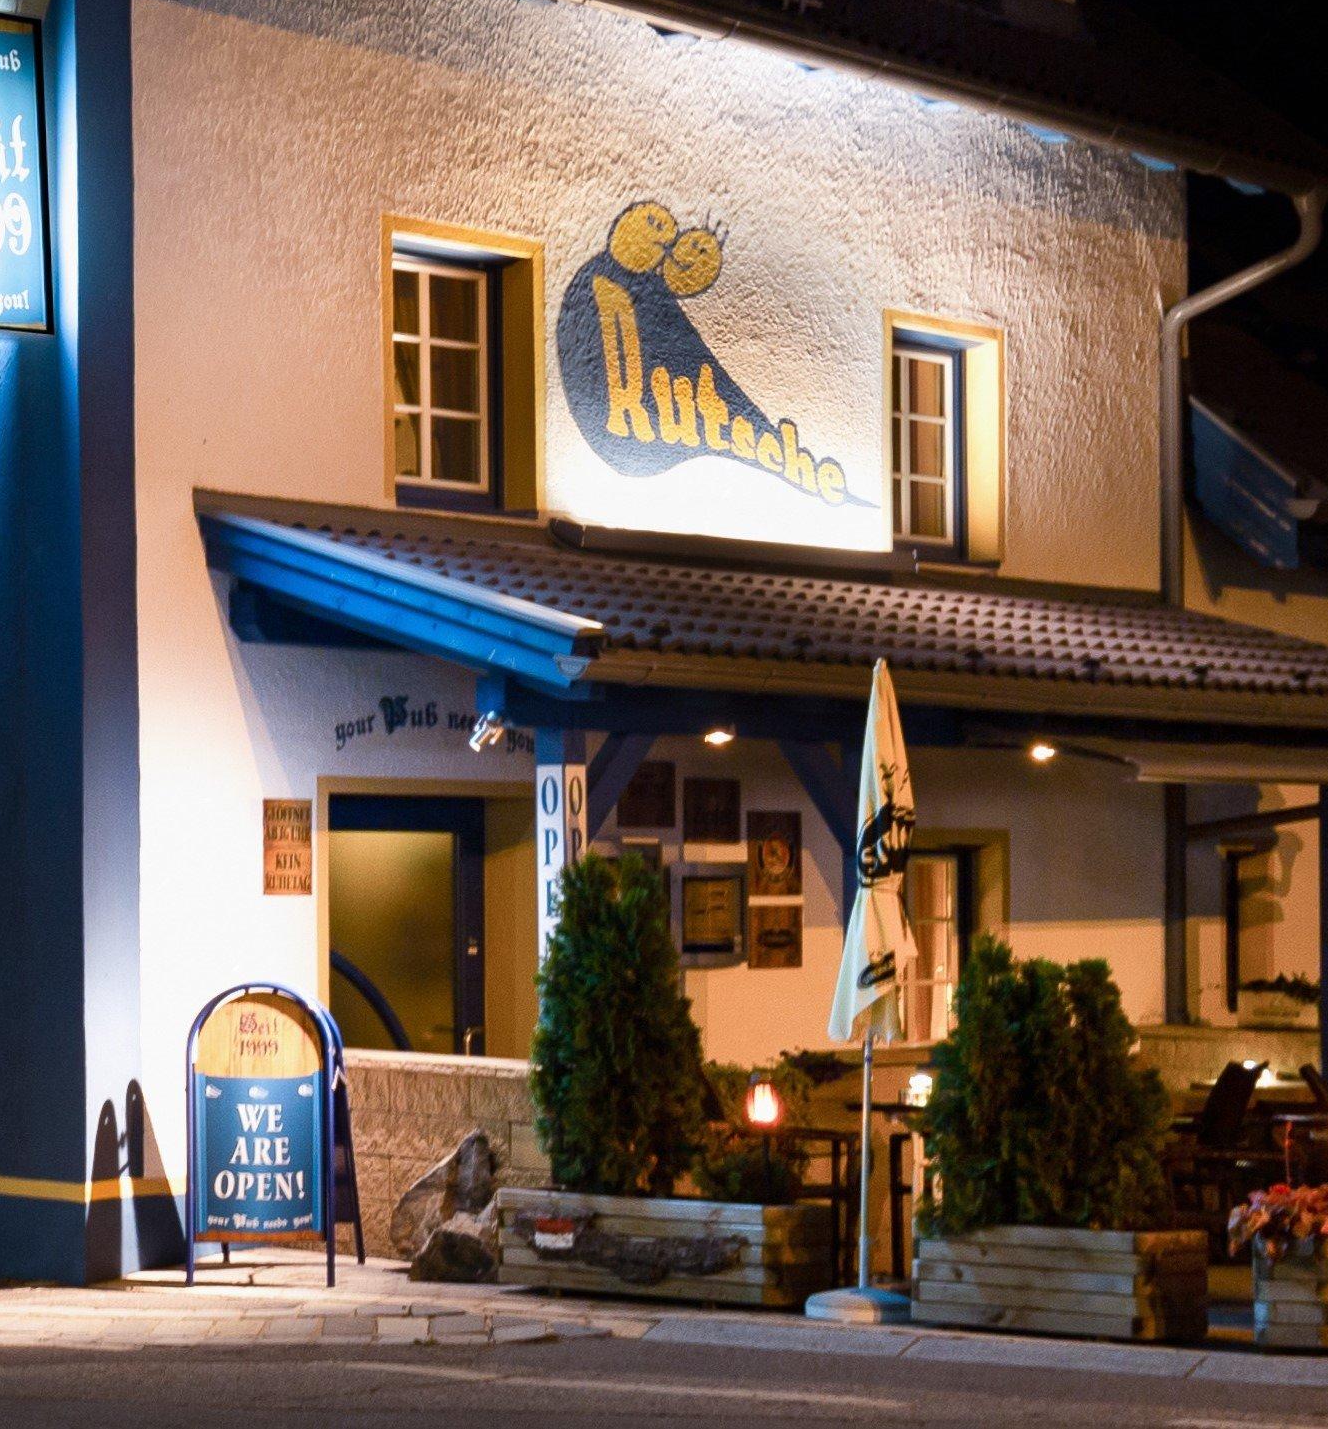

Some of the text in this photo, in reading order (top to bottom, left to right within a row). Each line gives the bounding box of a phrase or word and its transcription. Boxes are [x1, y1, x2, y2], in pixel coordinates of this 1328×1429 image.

[592, 275, 846, 503] Rutsche
[335, 714, 375, 751] your
[379, 695, 439, 735] Pub
[237, 1103, 283, 1133] WE
[229, 1136, 291, 1166] ARE
[214, 1169, 305, 1201] OPEN!
